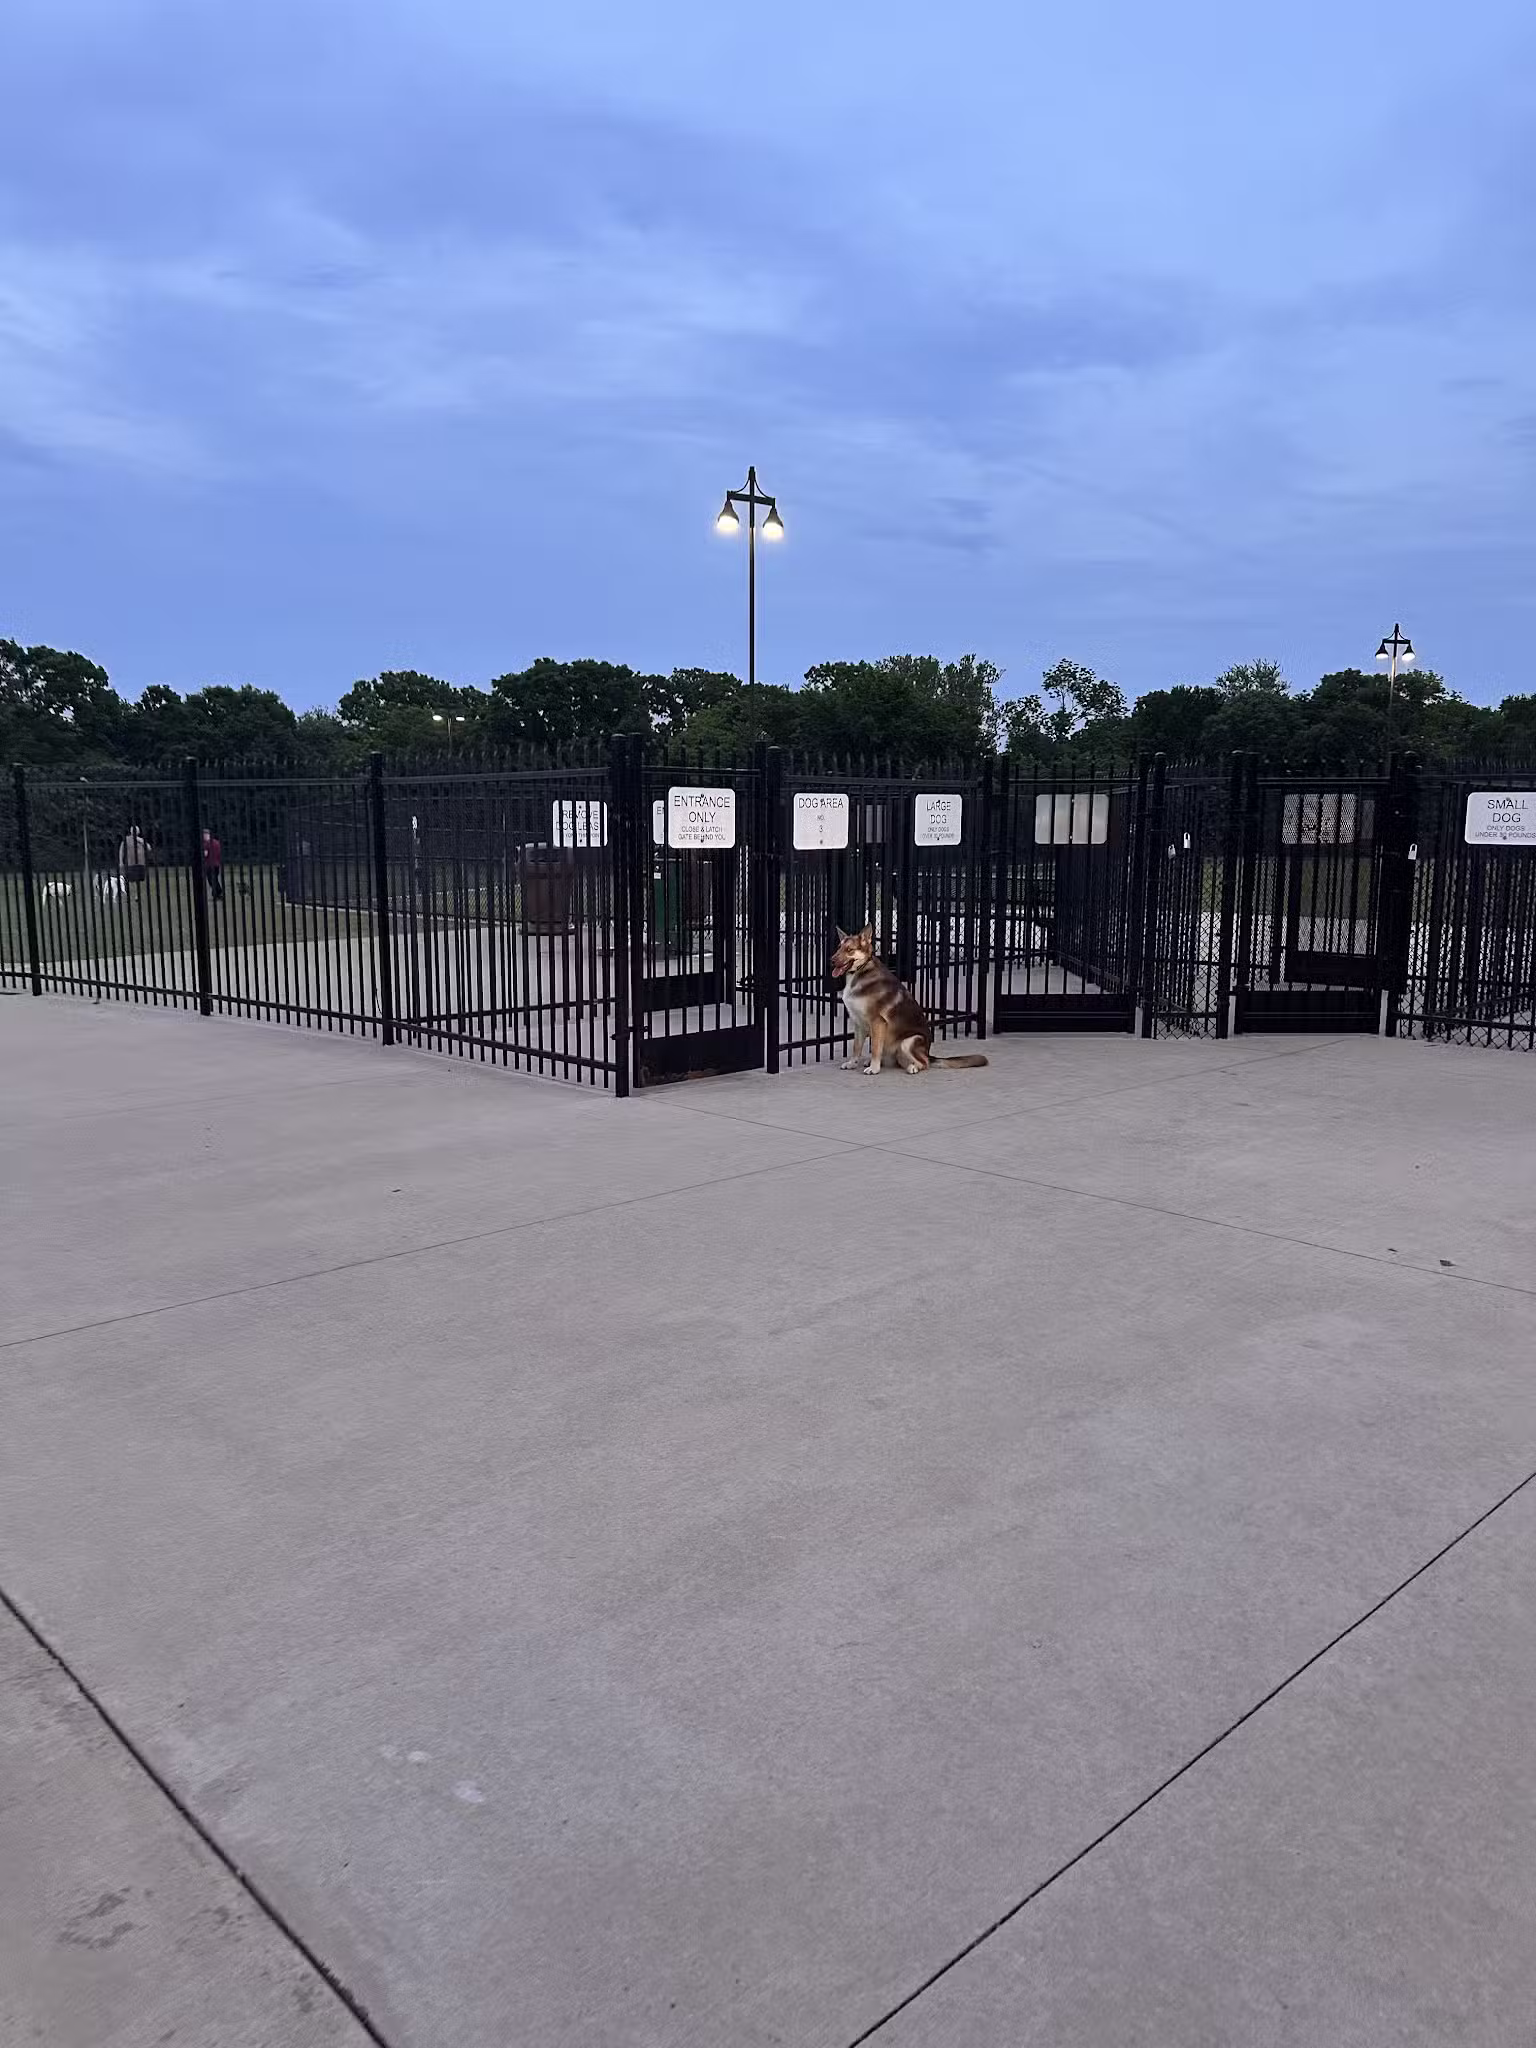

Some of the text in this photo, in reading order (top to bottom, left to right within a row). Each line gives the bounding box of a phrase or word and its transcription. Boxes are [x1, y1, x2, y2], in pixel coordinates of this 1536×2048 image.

[674, 795, 731, 808] ENTRANCE
[798, 797, 844, 809] DOG AREA
[926, 800, 951, 811] LARGE
[1487, 799, 1529, 810] SMALL
[688, 811, 716, 823] ONLY
[930, 814, 947, 824] DOG
[1492, 812, 1521, 823] DOG
[577, 821, 600, 831] LEAS
[681, 825, 700, 833] CLOSE
[819, 824, 824, 833] 3
[693, 833, 713, 841] BEHIND
